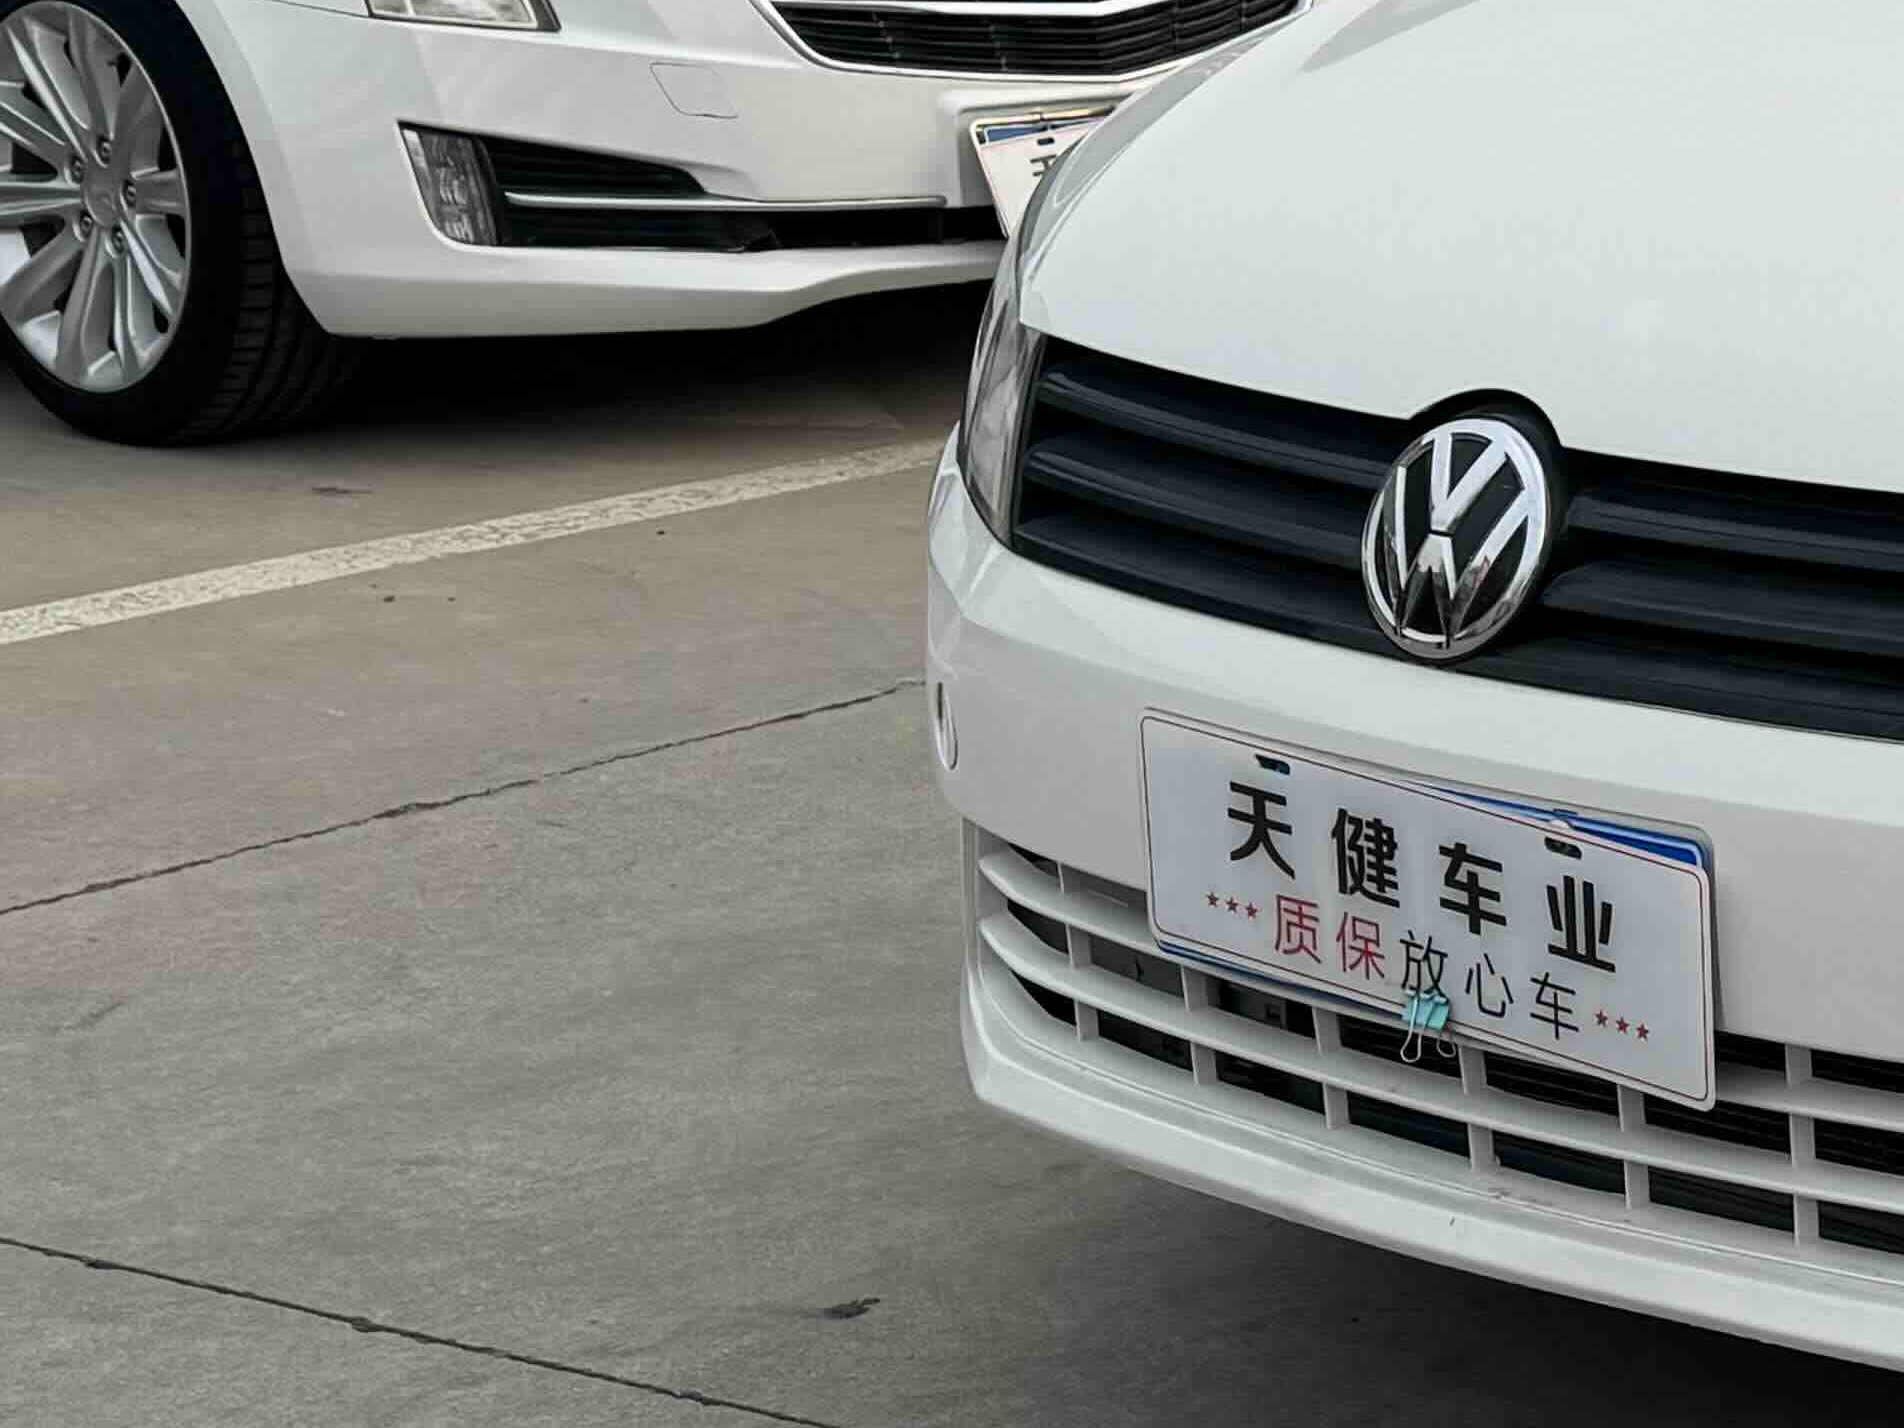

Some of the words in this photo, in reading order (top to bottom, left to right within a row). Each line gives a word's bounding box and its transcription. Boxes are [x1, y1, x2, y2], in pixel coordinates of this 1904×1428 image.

[1227, 780, 1617, 973] 天健车业
[1274, 894, 1580, 1039] 质保放心车
